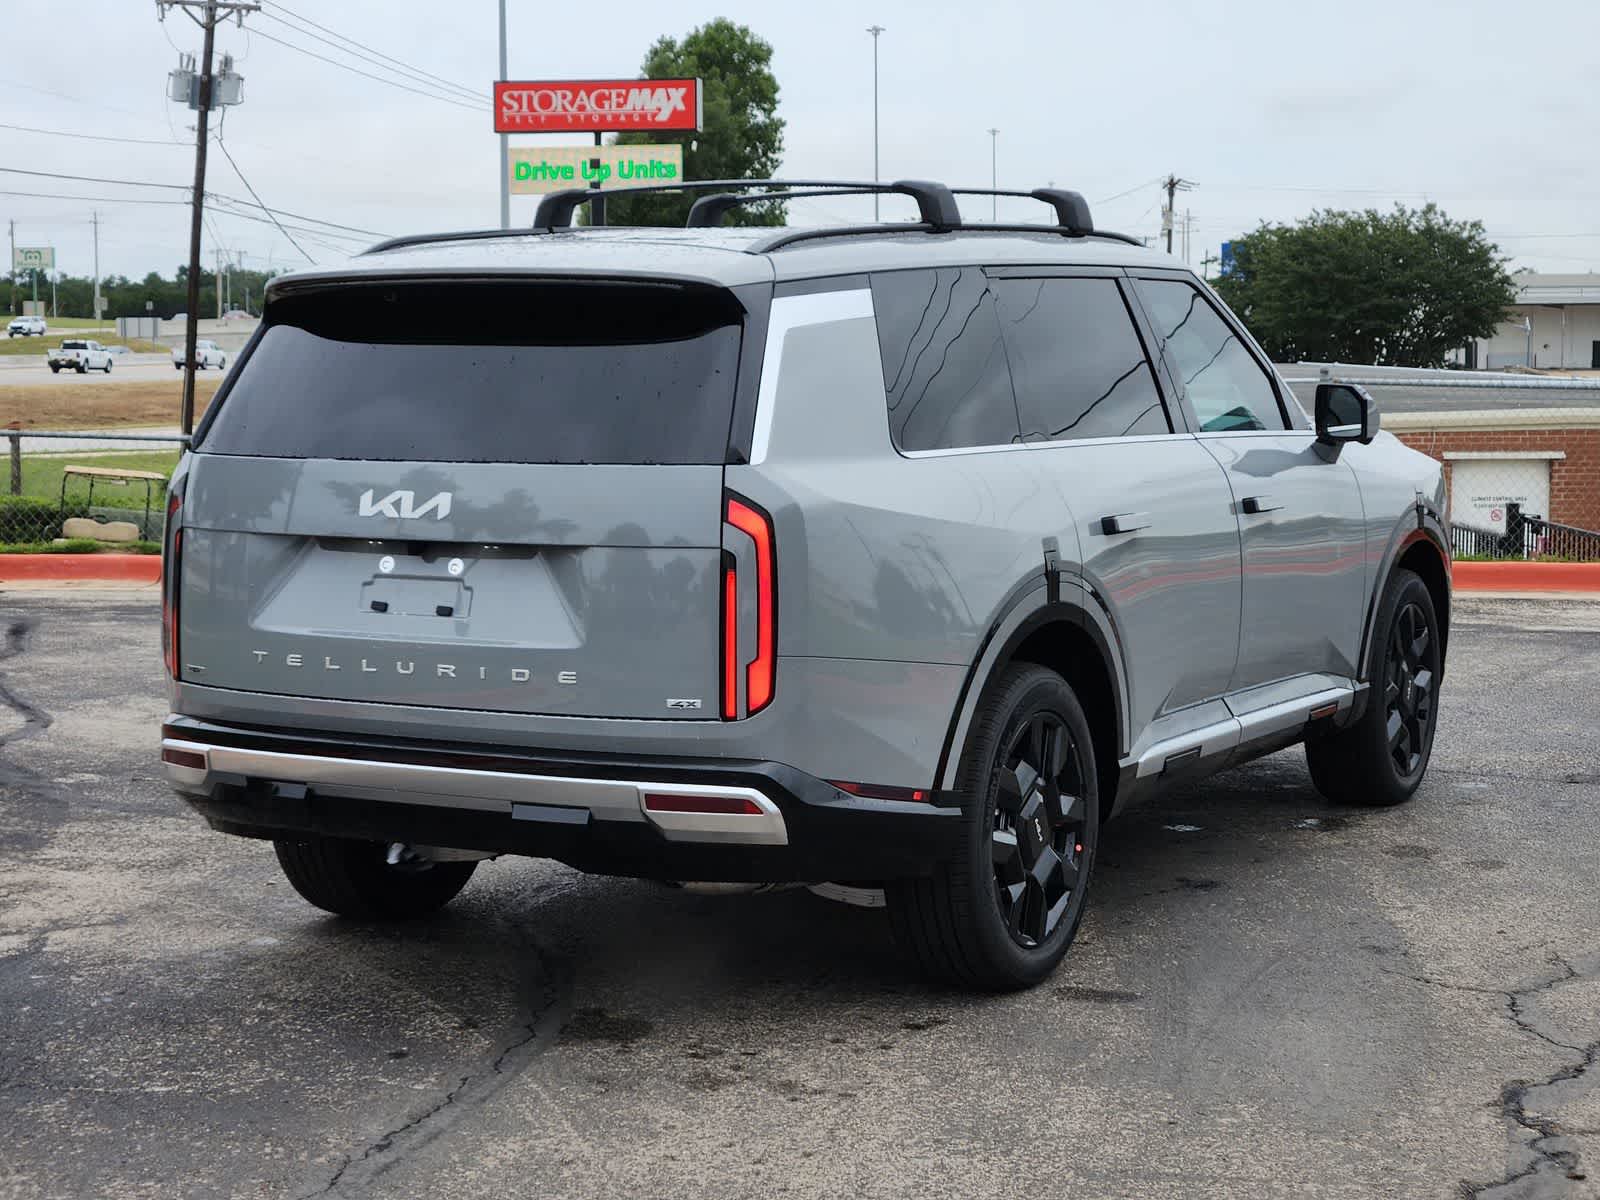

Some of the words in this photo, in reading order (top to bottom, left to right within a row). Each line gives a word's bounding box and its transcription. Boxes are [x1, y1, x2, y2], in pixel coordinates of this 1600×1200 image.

[502, 88, 686, 121] STORAGEMAX
[515, 160, 574, 180] Drive
[581, 159, 611, 182] Up
[618, 159, 677, 180] Units
[359, 488, 452, 520] KIA
[252, 650, 577, 684] TELLURIDE
